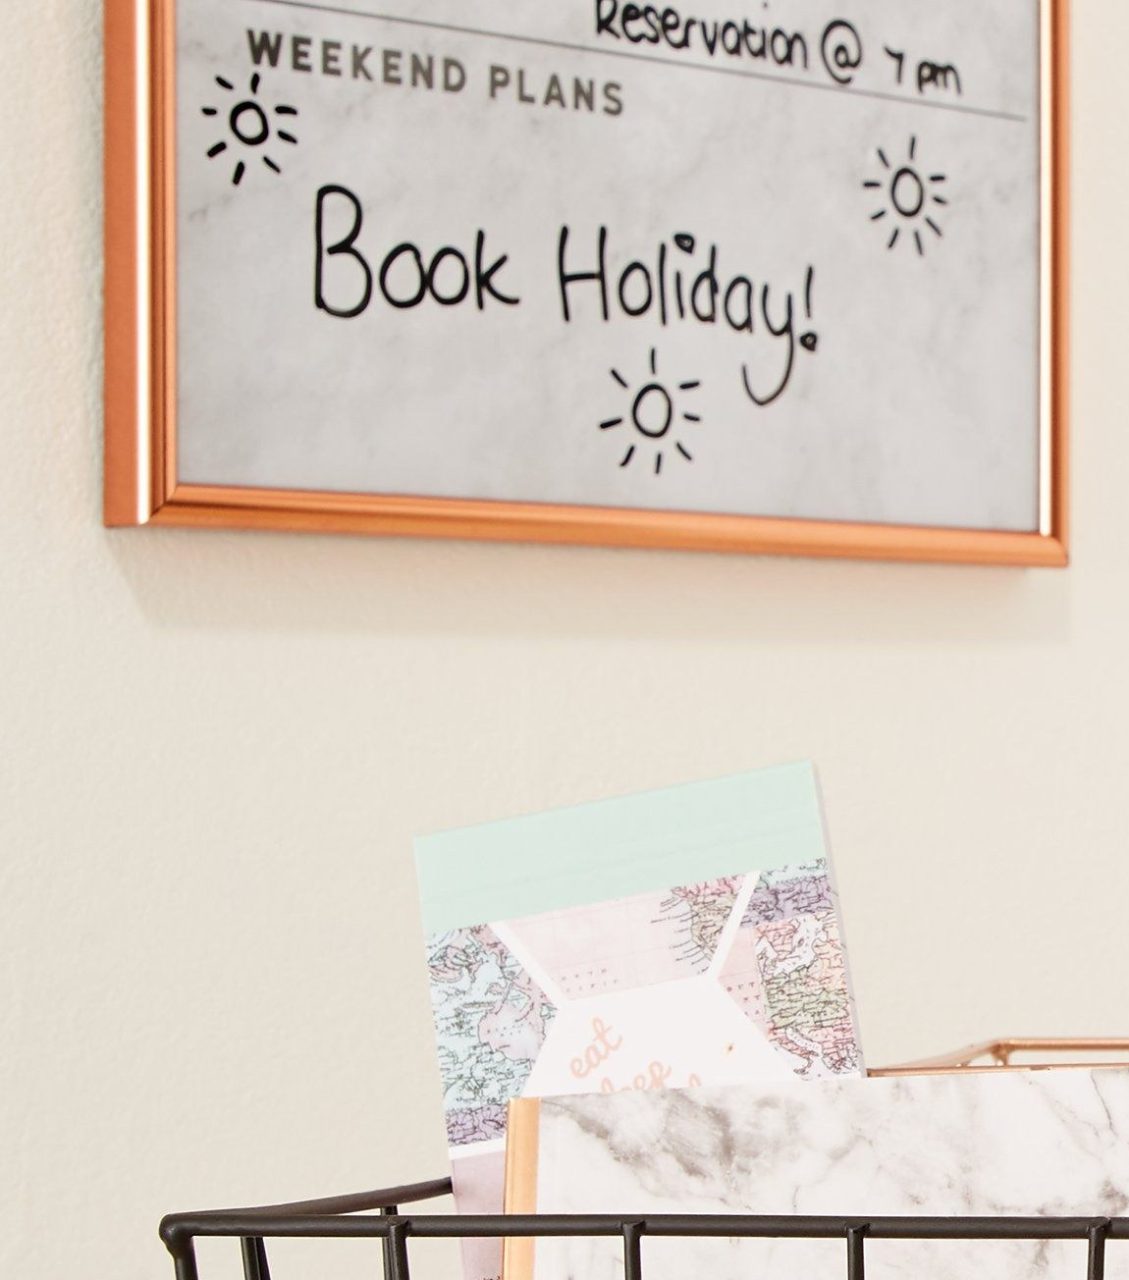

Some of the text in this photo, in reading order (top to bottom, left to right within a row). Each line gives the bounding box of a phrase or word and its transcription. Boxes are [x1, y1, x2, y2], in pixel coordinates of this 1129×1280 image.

[247, 29, 624, 116] WEEKEND PLANS
[596, 0, 808, 69] Reservation
[820, 19, 862, 84] @
[917, 60, 962, 95] pm
[315, 184, 818, 406] Book Holiday!
[570, 1016, 623, 1078] eat
